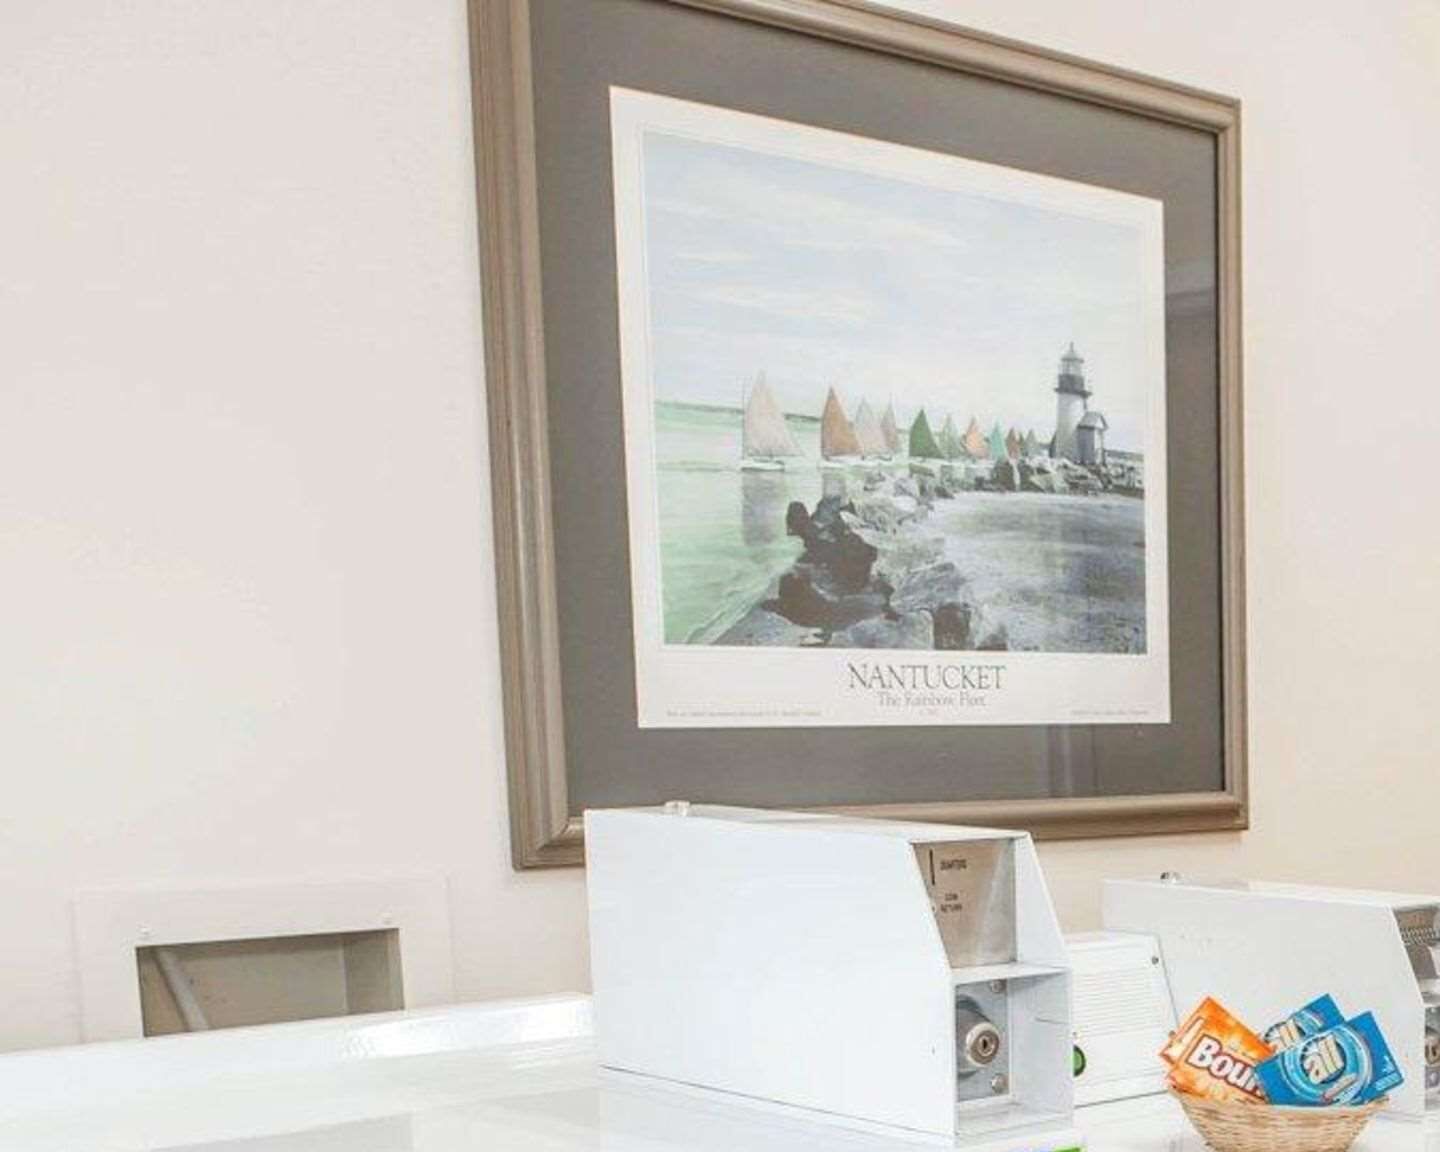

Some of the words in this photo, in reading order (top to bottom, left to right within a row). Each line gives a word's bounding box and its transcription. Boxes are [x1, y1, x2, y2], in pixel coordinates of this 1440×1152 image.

[848, 661, 1007, 690] NANTUCKET
[877, 691, 902, 707] The
[1304, 1032, 1345, 1085] all
